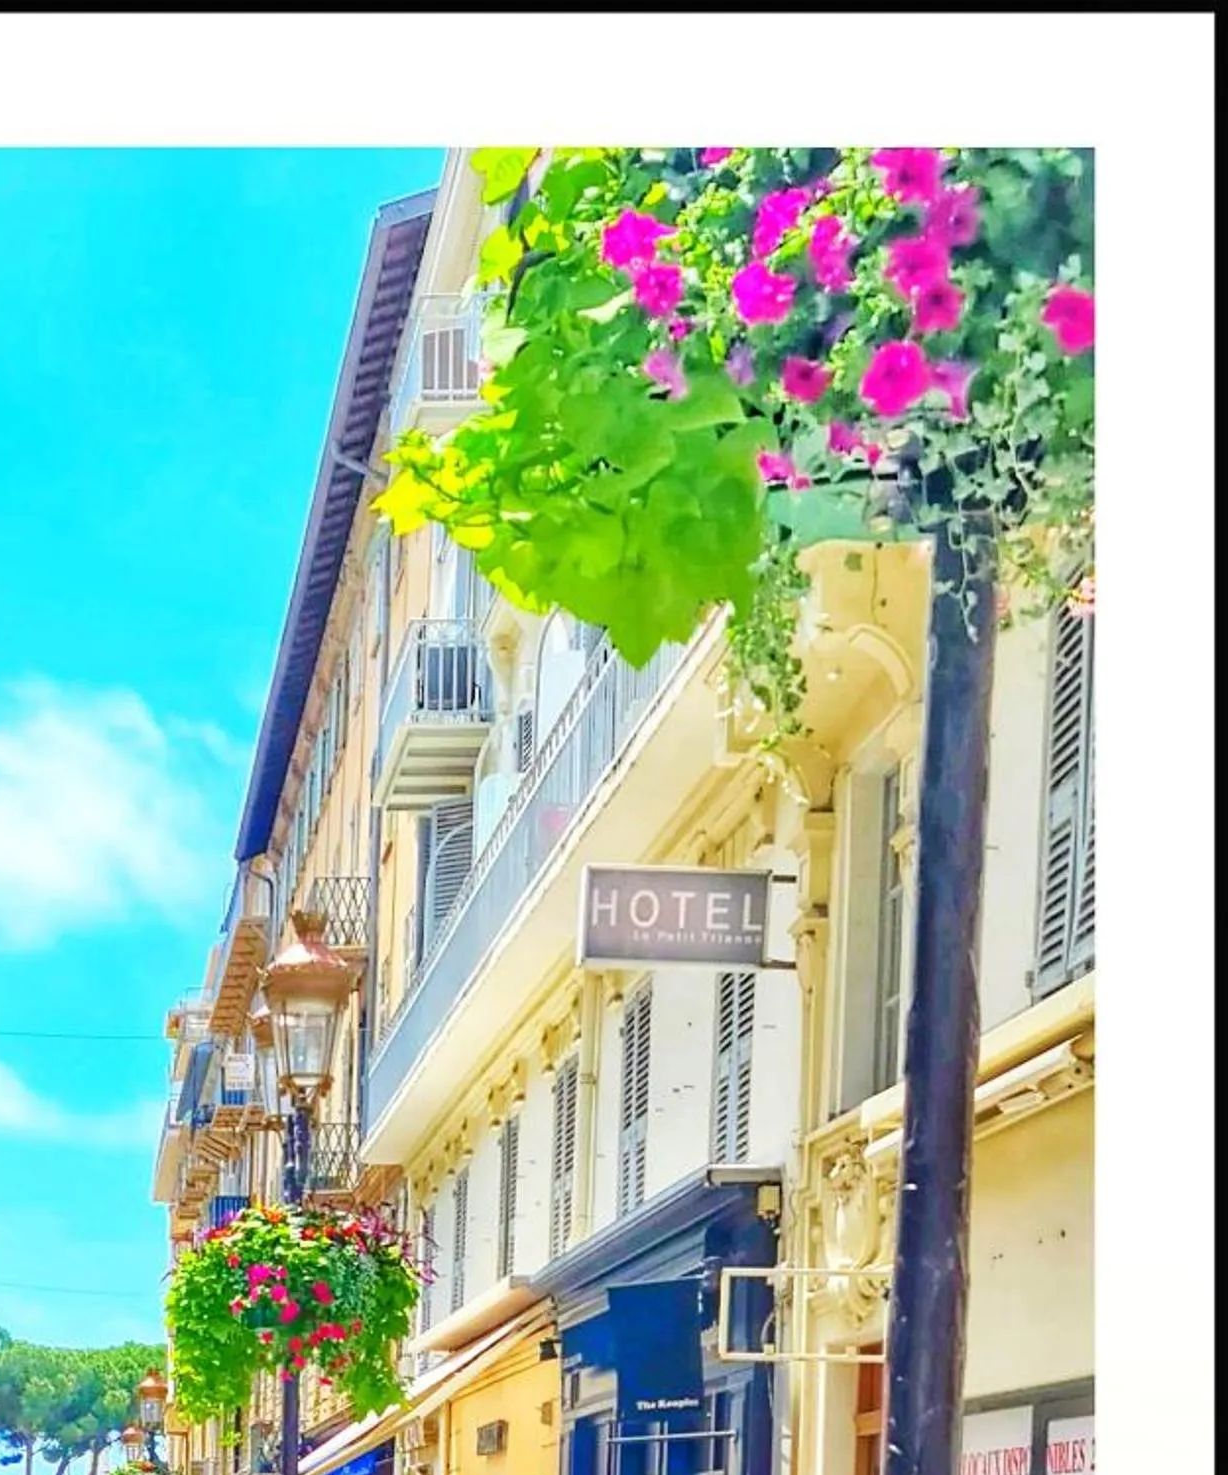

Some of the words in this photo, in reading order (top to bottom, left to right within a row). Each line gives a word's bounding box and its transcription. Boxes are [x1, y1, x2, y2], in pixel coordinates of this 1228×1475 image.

[591, 888, 763, 931] HOTEL
[657, 930, 696, 944] Petit
[636, 1400, 656, 1411] The
